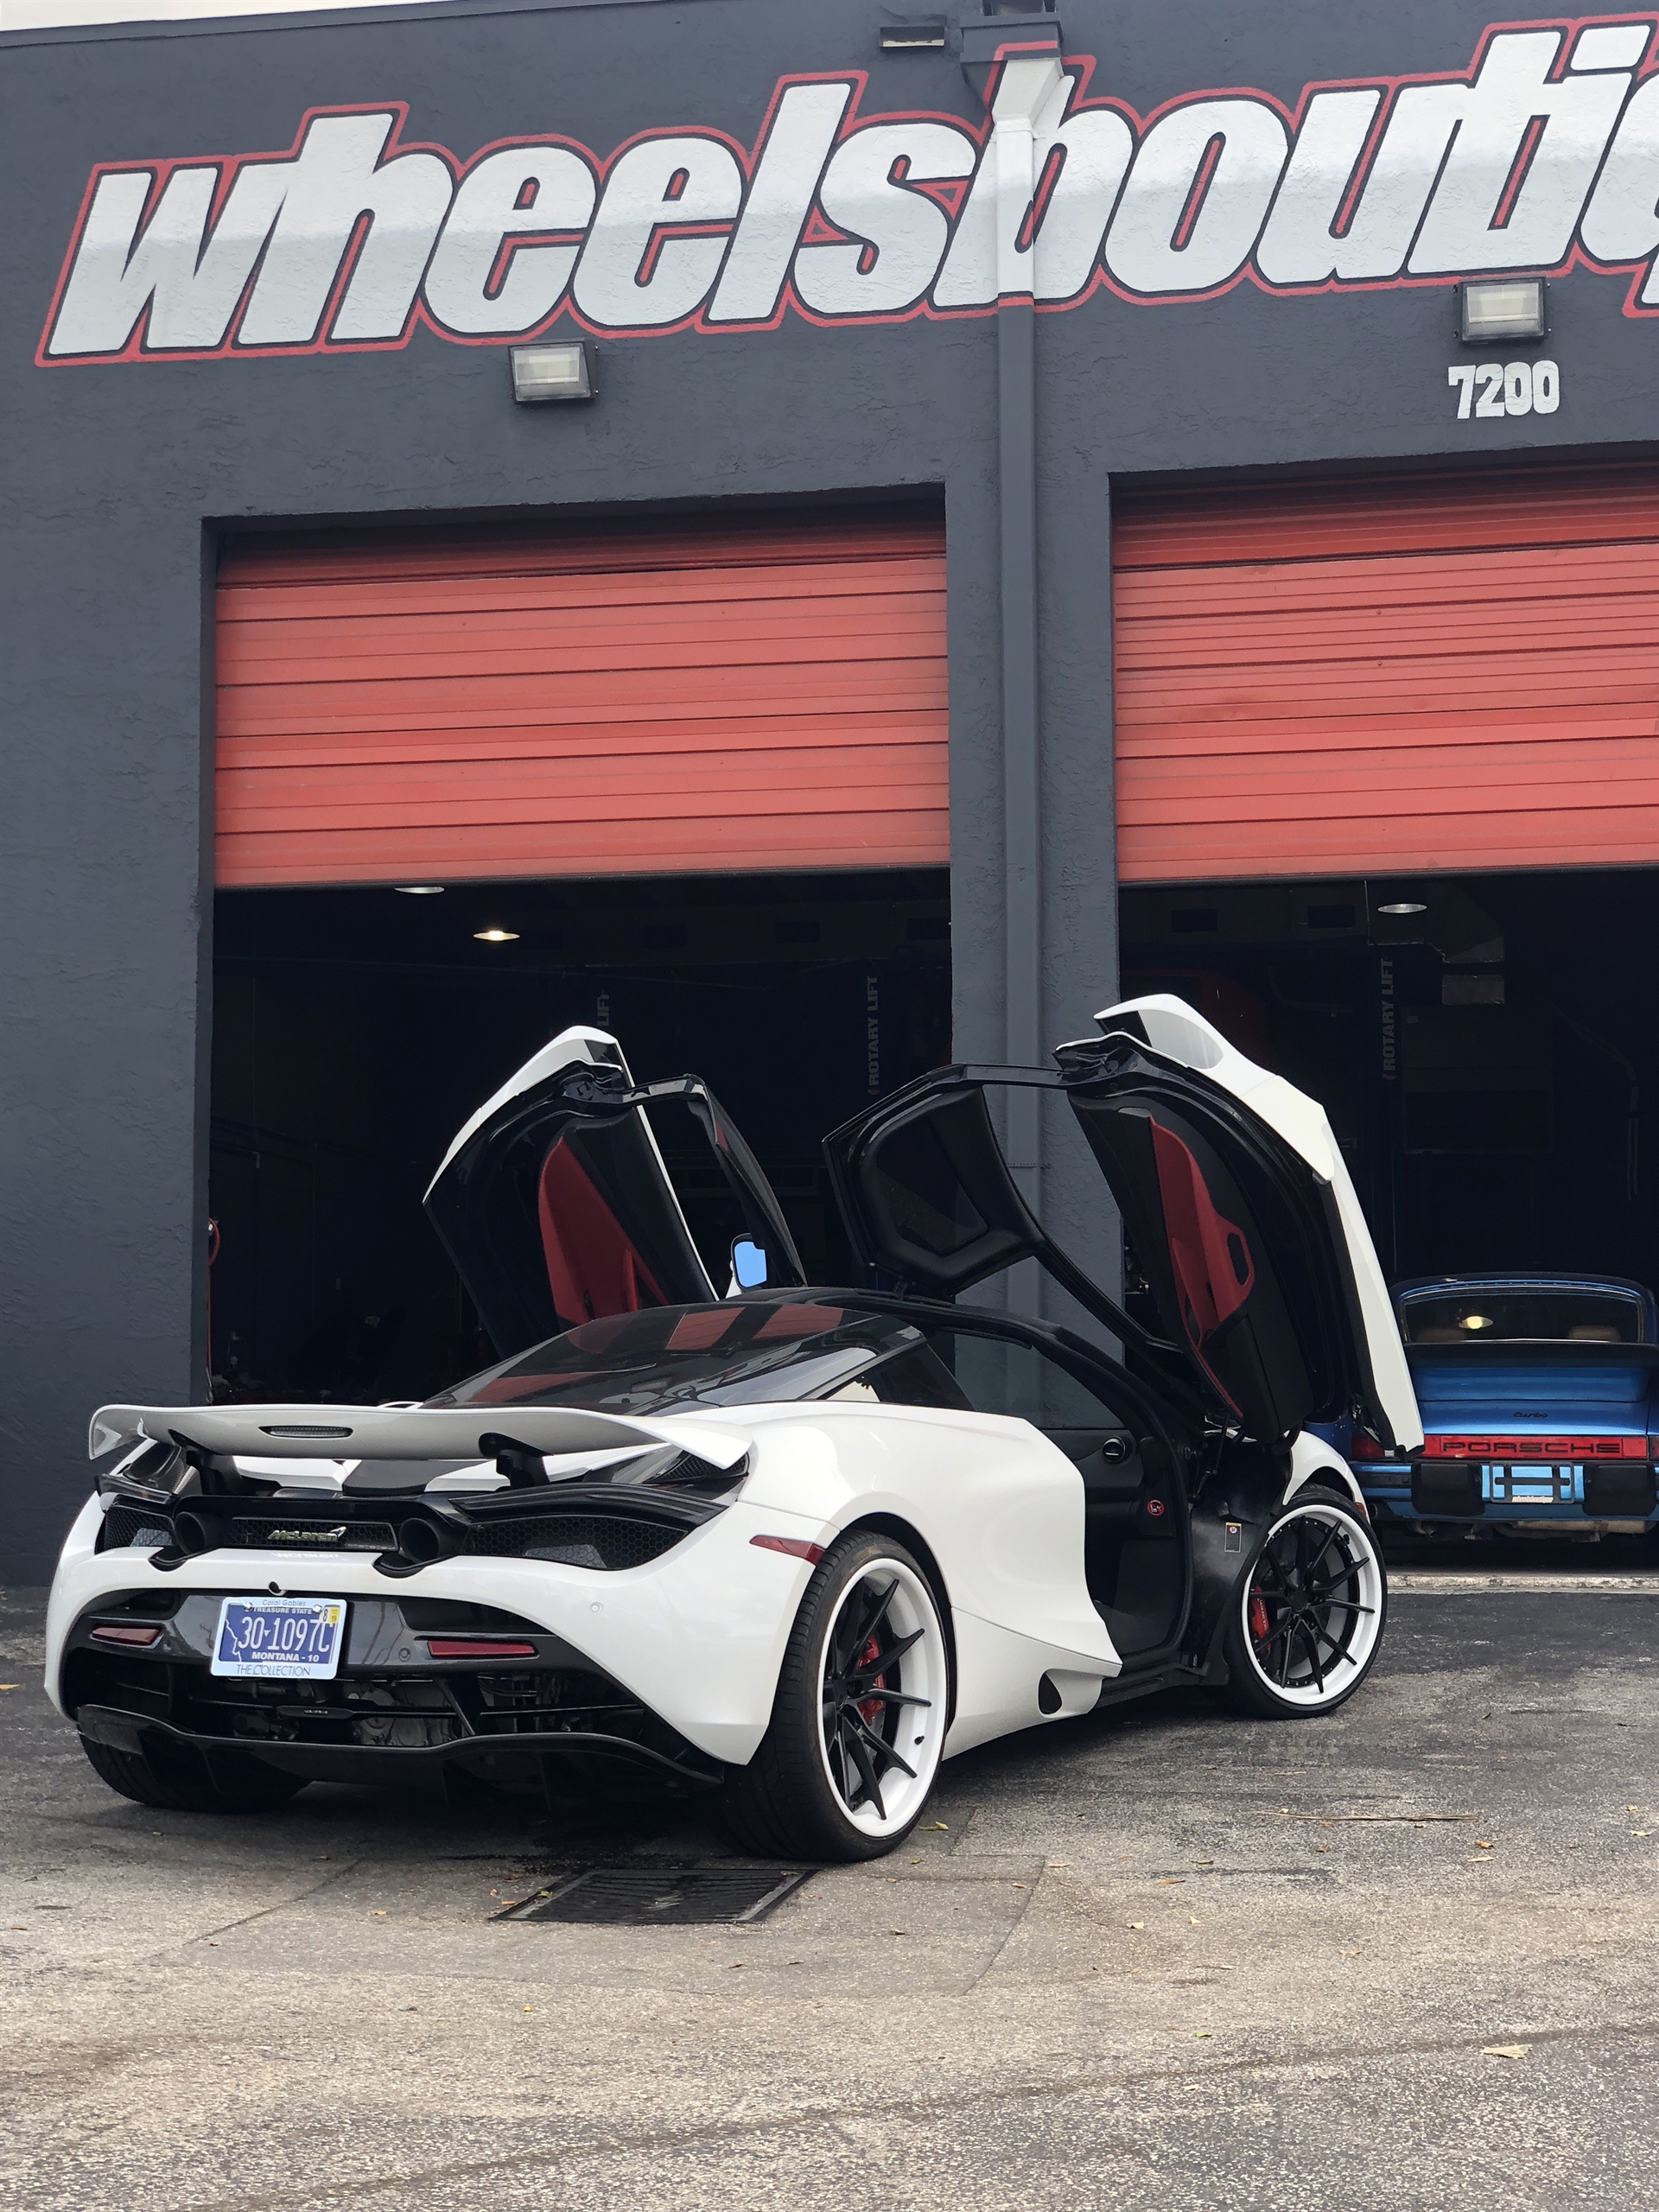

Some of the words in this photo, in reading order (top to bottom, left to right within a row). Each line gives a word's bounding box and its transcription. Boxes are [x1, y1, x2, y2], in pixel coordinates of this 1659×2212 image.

[1448, 359, 1560, 419] 7200
[867, 976, 879, 1011] LIFT
[1381, 958, 1394, 995] LIFT
[868, 1016, 880, 1086] ROTARY
[1382, 1001, 1395, 1071] ROTARY
[1443, 1441, 1620, 1454] PORSCHE
[268, 1529, 338, 1542] McLaren
[237, 1664, 253, 1675] THE
[252, 1664, 311, 1677] COLLECTION
[251, 1651, 300, 1662] MONTANA
